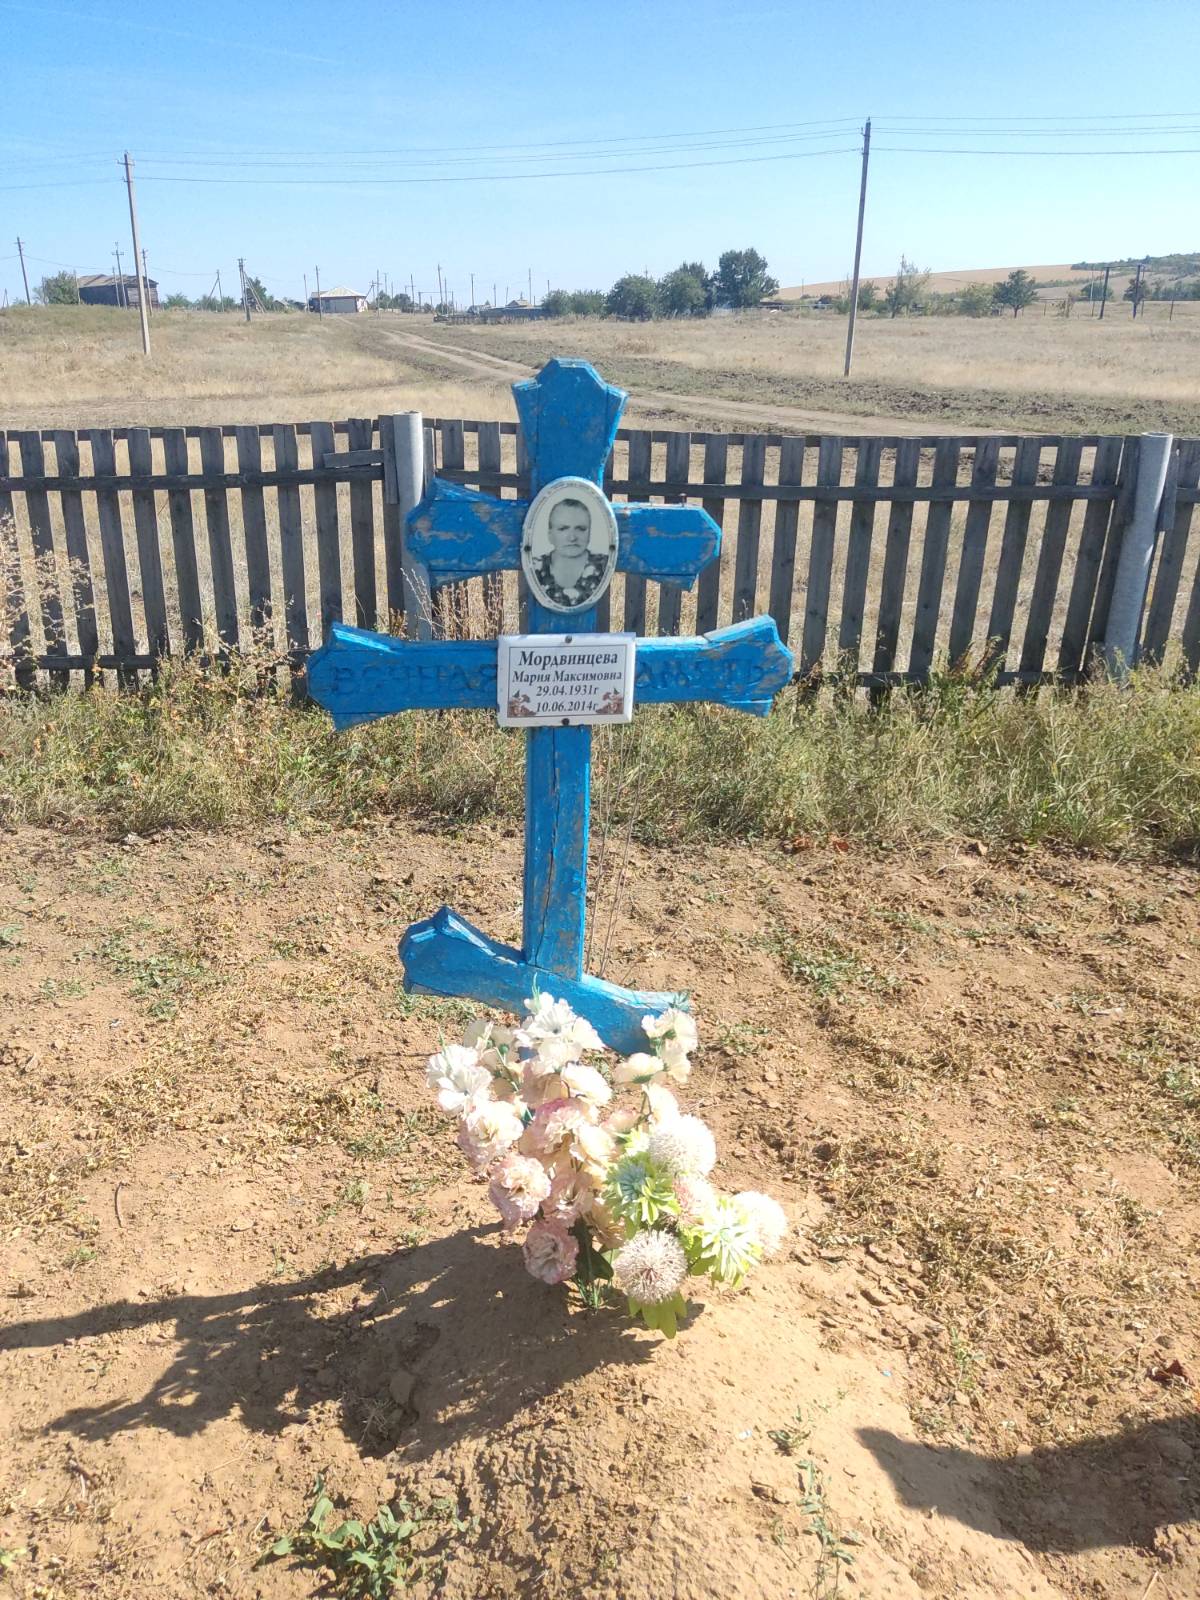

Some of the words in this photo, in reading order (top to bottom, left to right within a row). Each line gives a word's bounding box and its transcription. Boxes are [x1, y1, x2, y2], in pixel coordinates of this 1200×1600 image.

[519, 651, 618, 670] Мордвинцева
[513, 670, 551, 686] Мария
[553, 670, 622, 682] Максимовна
[536, 685, 599, 697] 29.04.1931г
